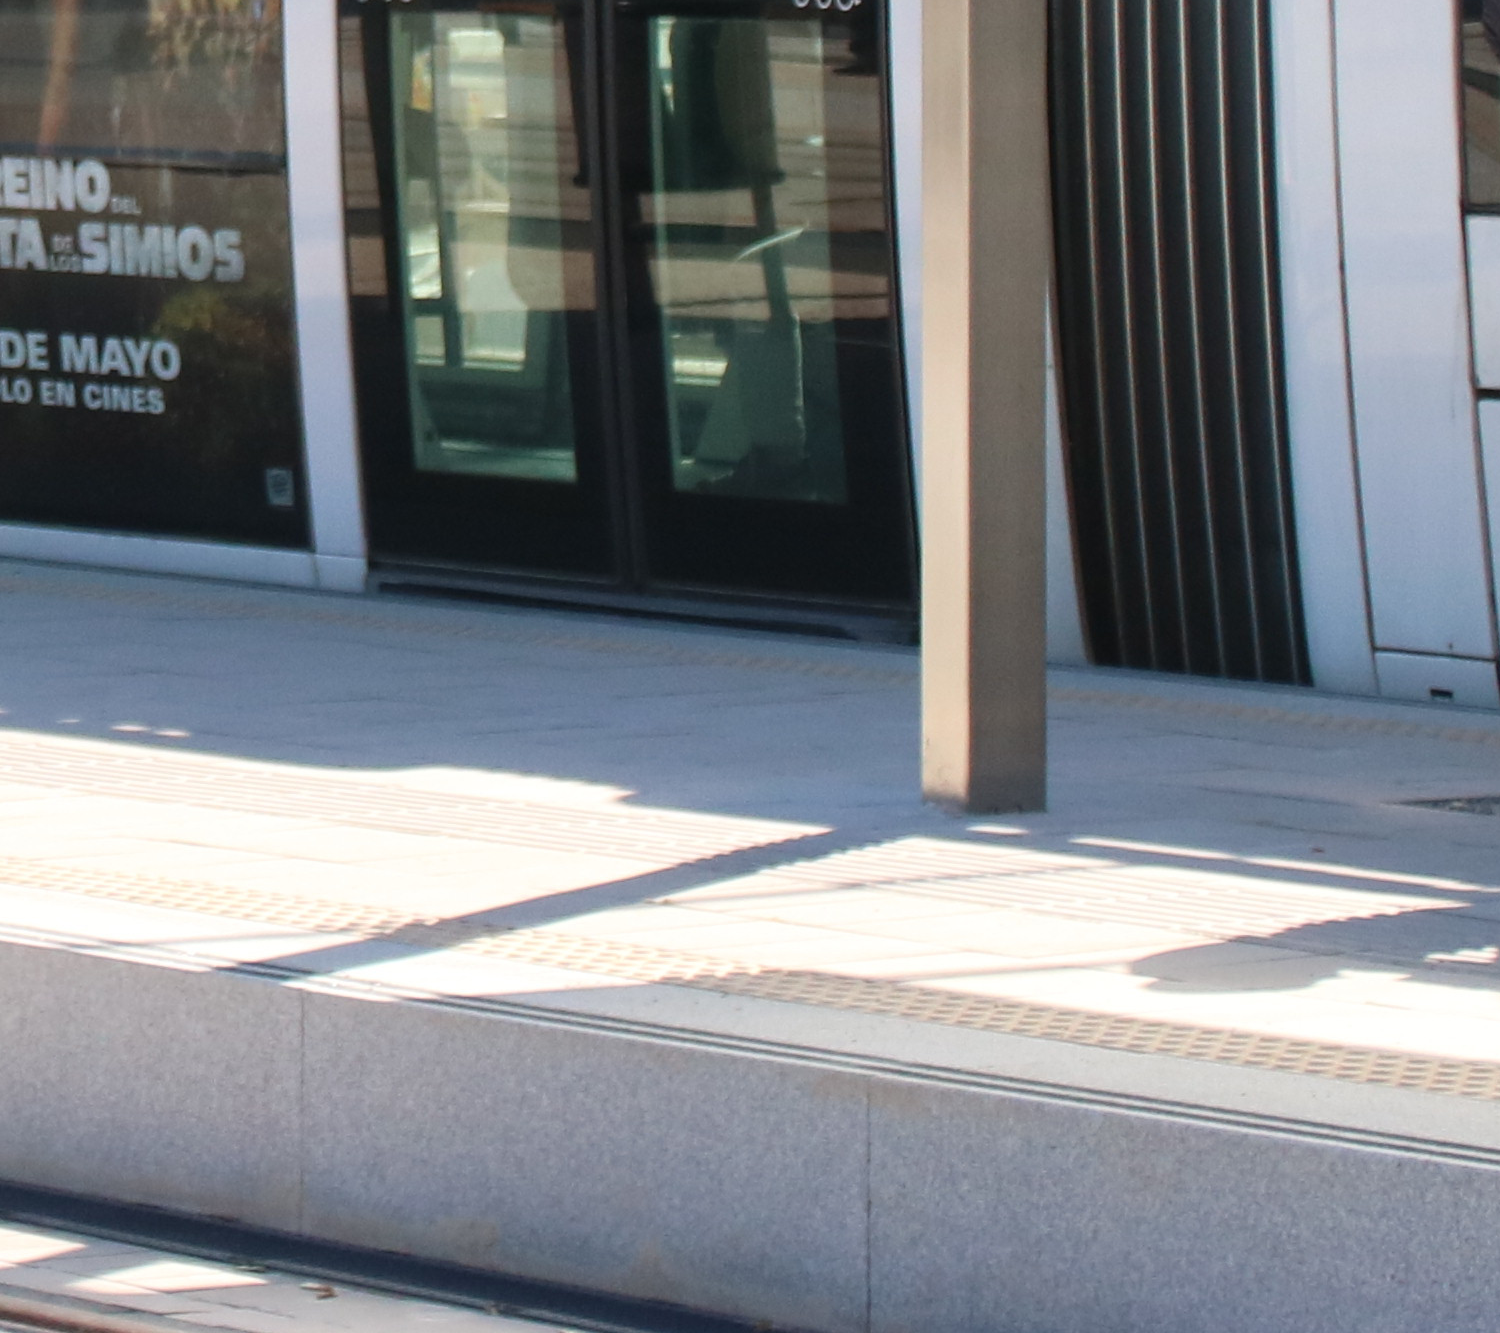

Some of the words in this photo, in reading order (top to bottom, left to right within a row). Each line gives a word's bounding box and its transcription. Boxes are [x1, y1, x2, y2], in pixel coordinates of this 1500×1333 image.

[57, 333, 183, 381] MAYO
[39, 379, 77, 409] EN
[82, 382, 166, 415] CINES
